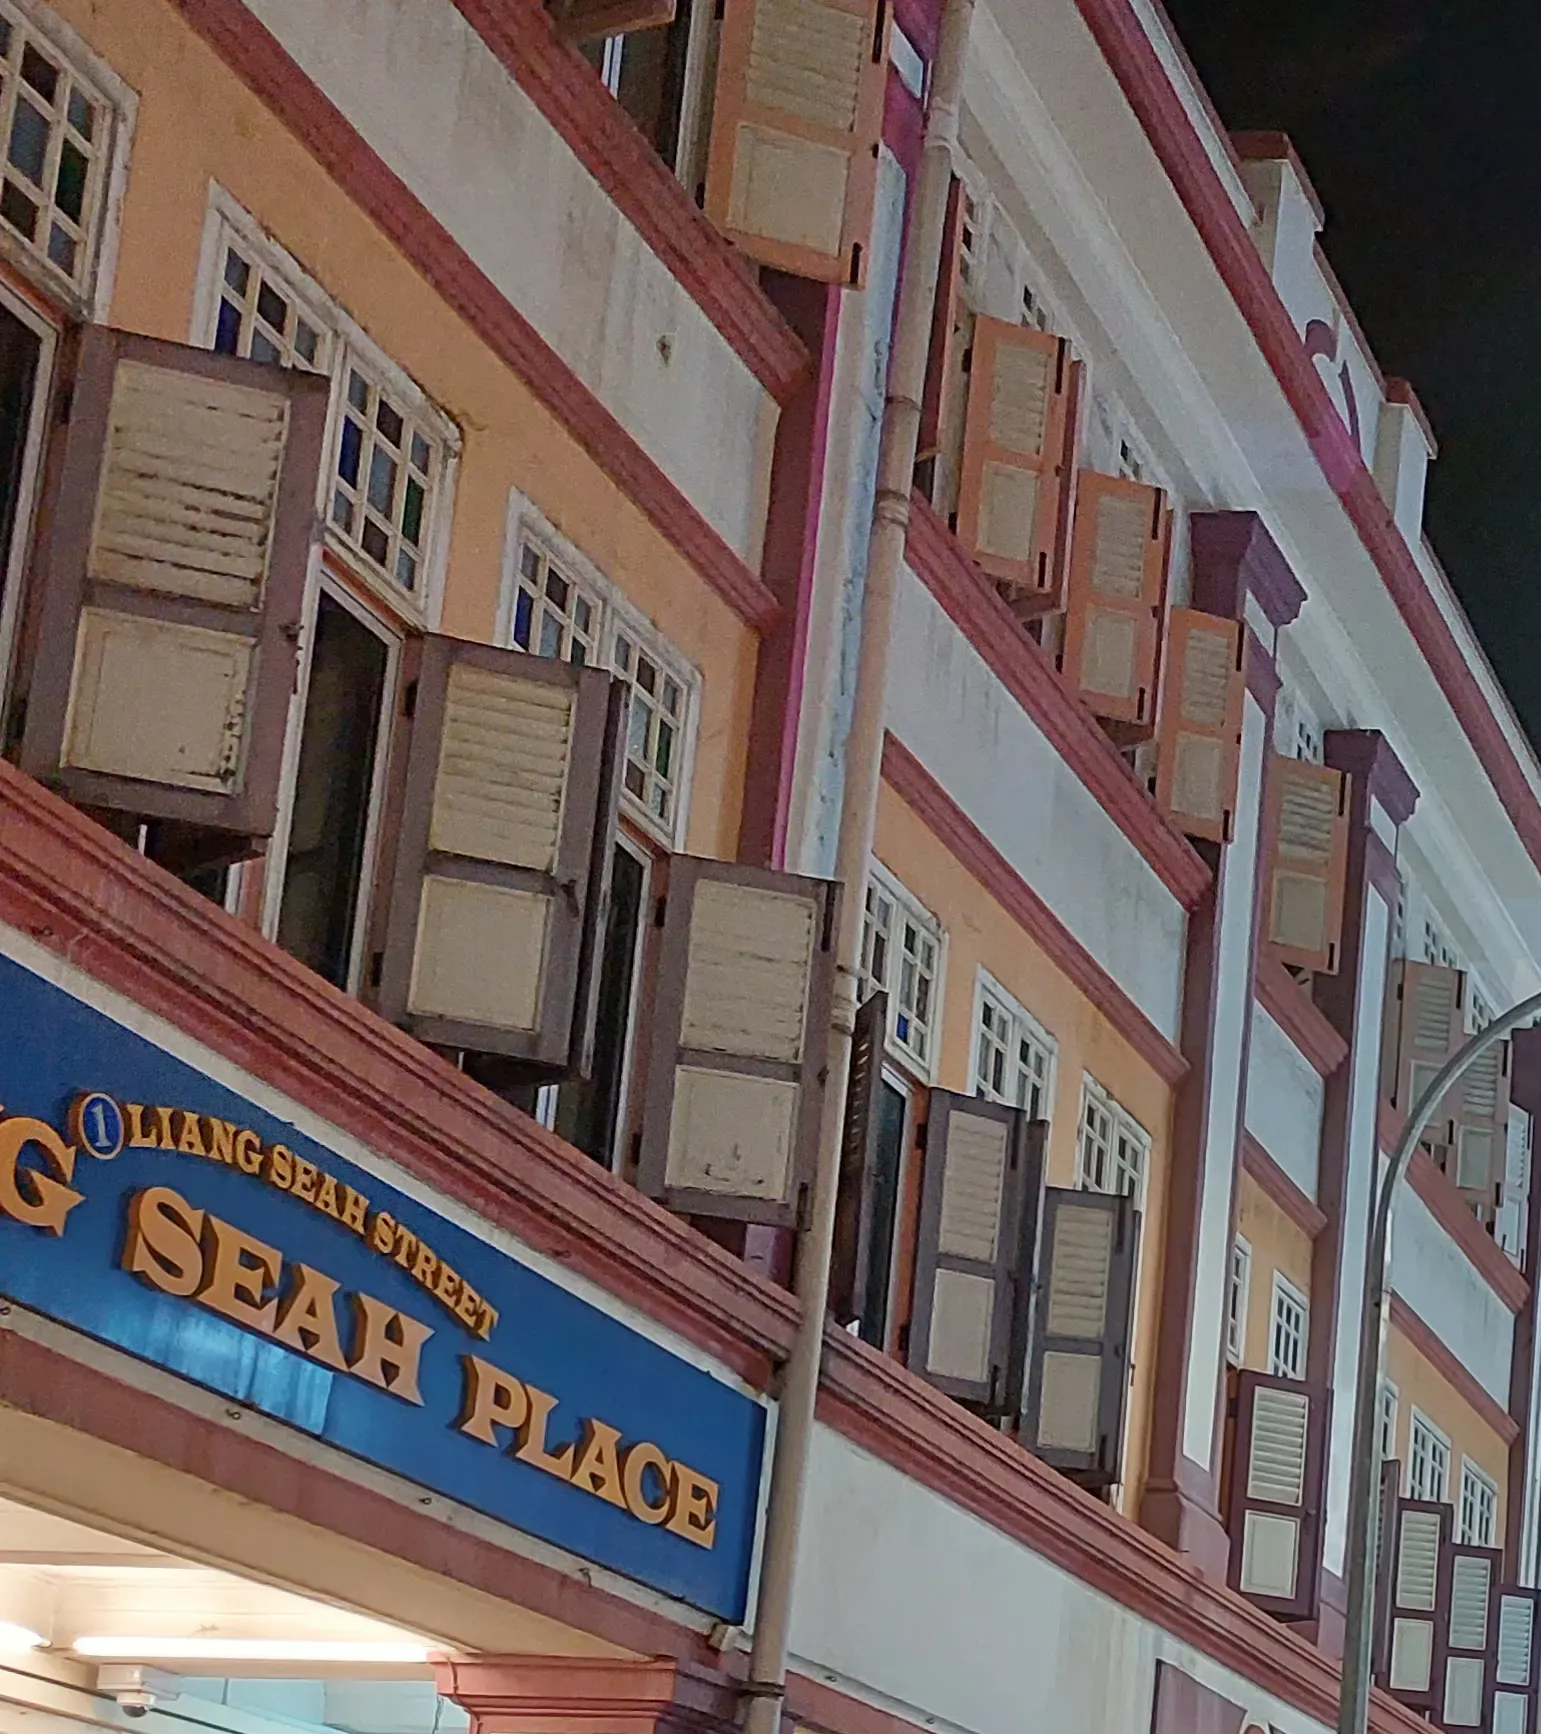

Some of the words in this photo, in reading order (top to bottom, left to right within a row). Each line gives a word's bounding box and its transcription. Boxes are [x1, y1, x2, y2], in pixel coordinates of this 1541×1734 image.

[0, 1110, 86, 1238] G
[121, 1185, 437, 1406] SEAH
[457, 1352, 720, 1551] PLACE
[125, 1103, 267, 1177] LIANG
[270, 1143, 370, 1235] SEAH
[370, 1210, 500, 1344] STREET
